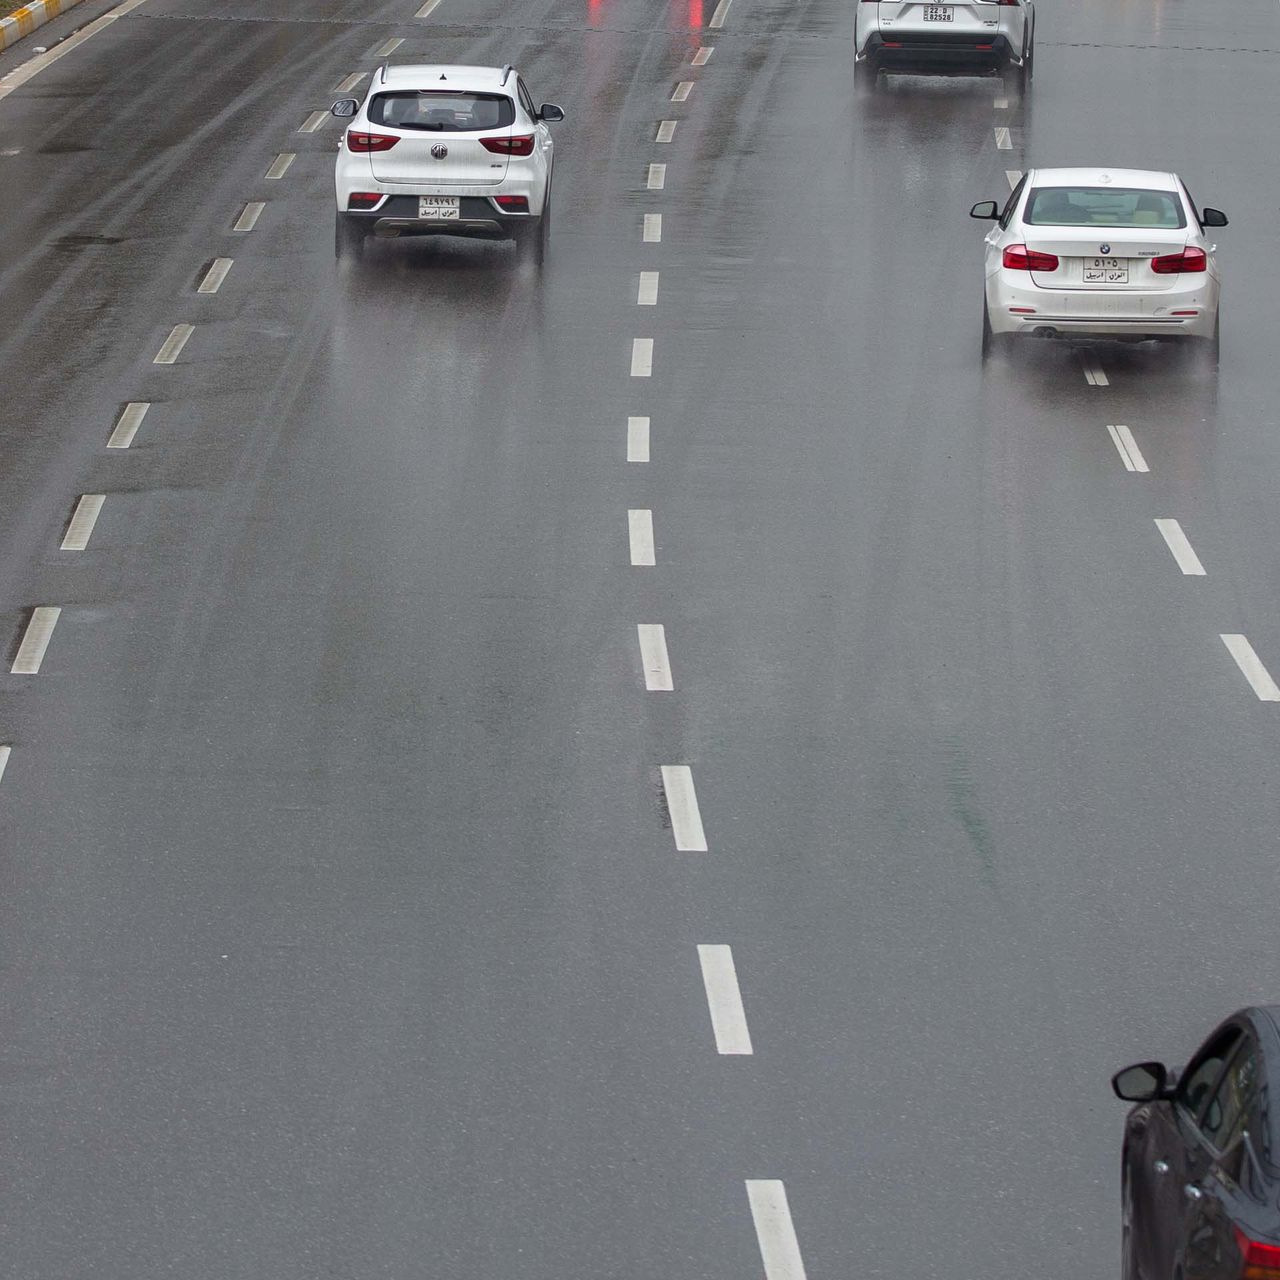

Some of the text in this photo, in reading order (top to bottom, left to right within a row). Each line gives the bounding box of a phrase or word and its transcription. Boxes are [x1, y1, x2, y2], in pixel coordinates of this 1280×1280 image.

[423, 197, 456, 206] ٦٤٩٧٩٢
[1094, 259, 1118, 267] ٥١٠٥
[1086, 271, 1104, 280] اربيل
